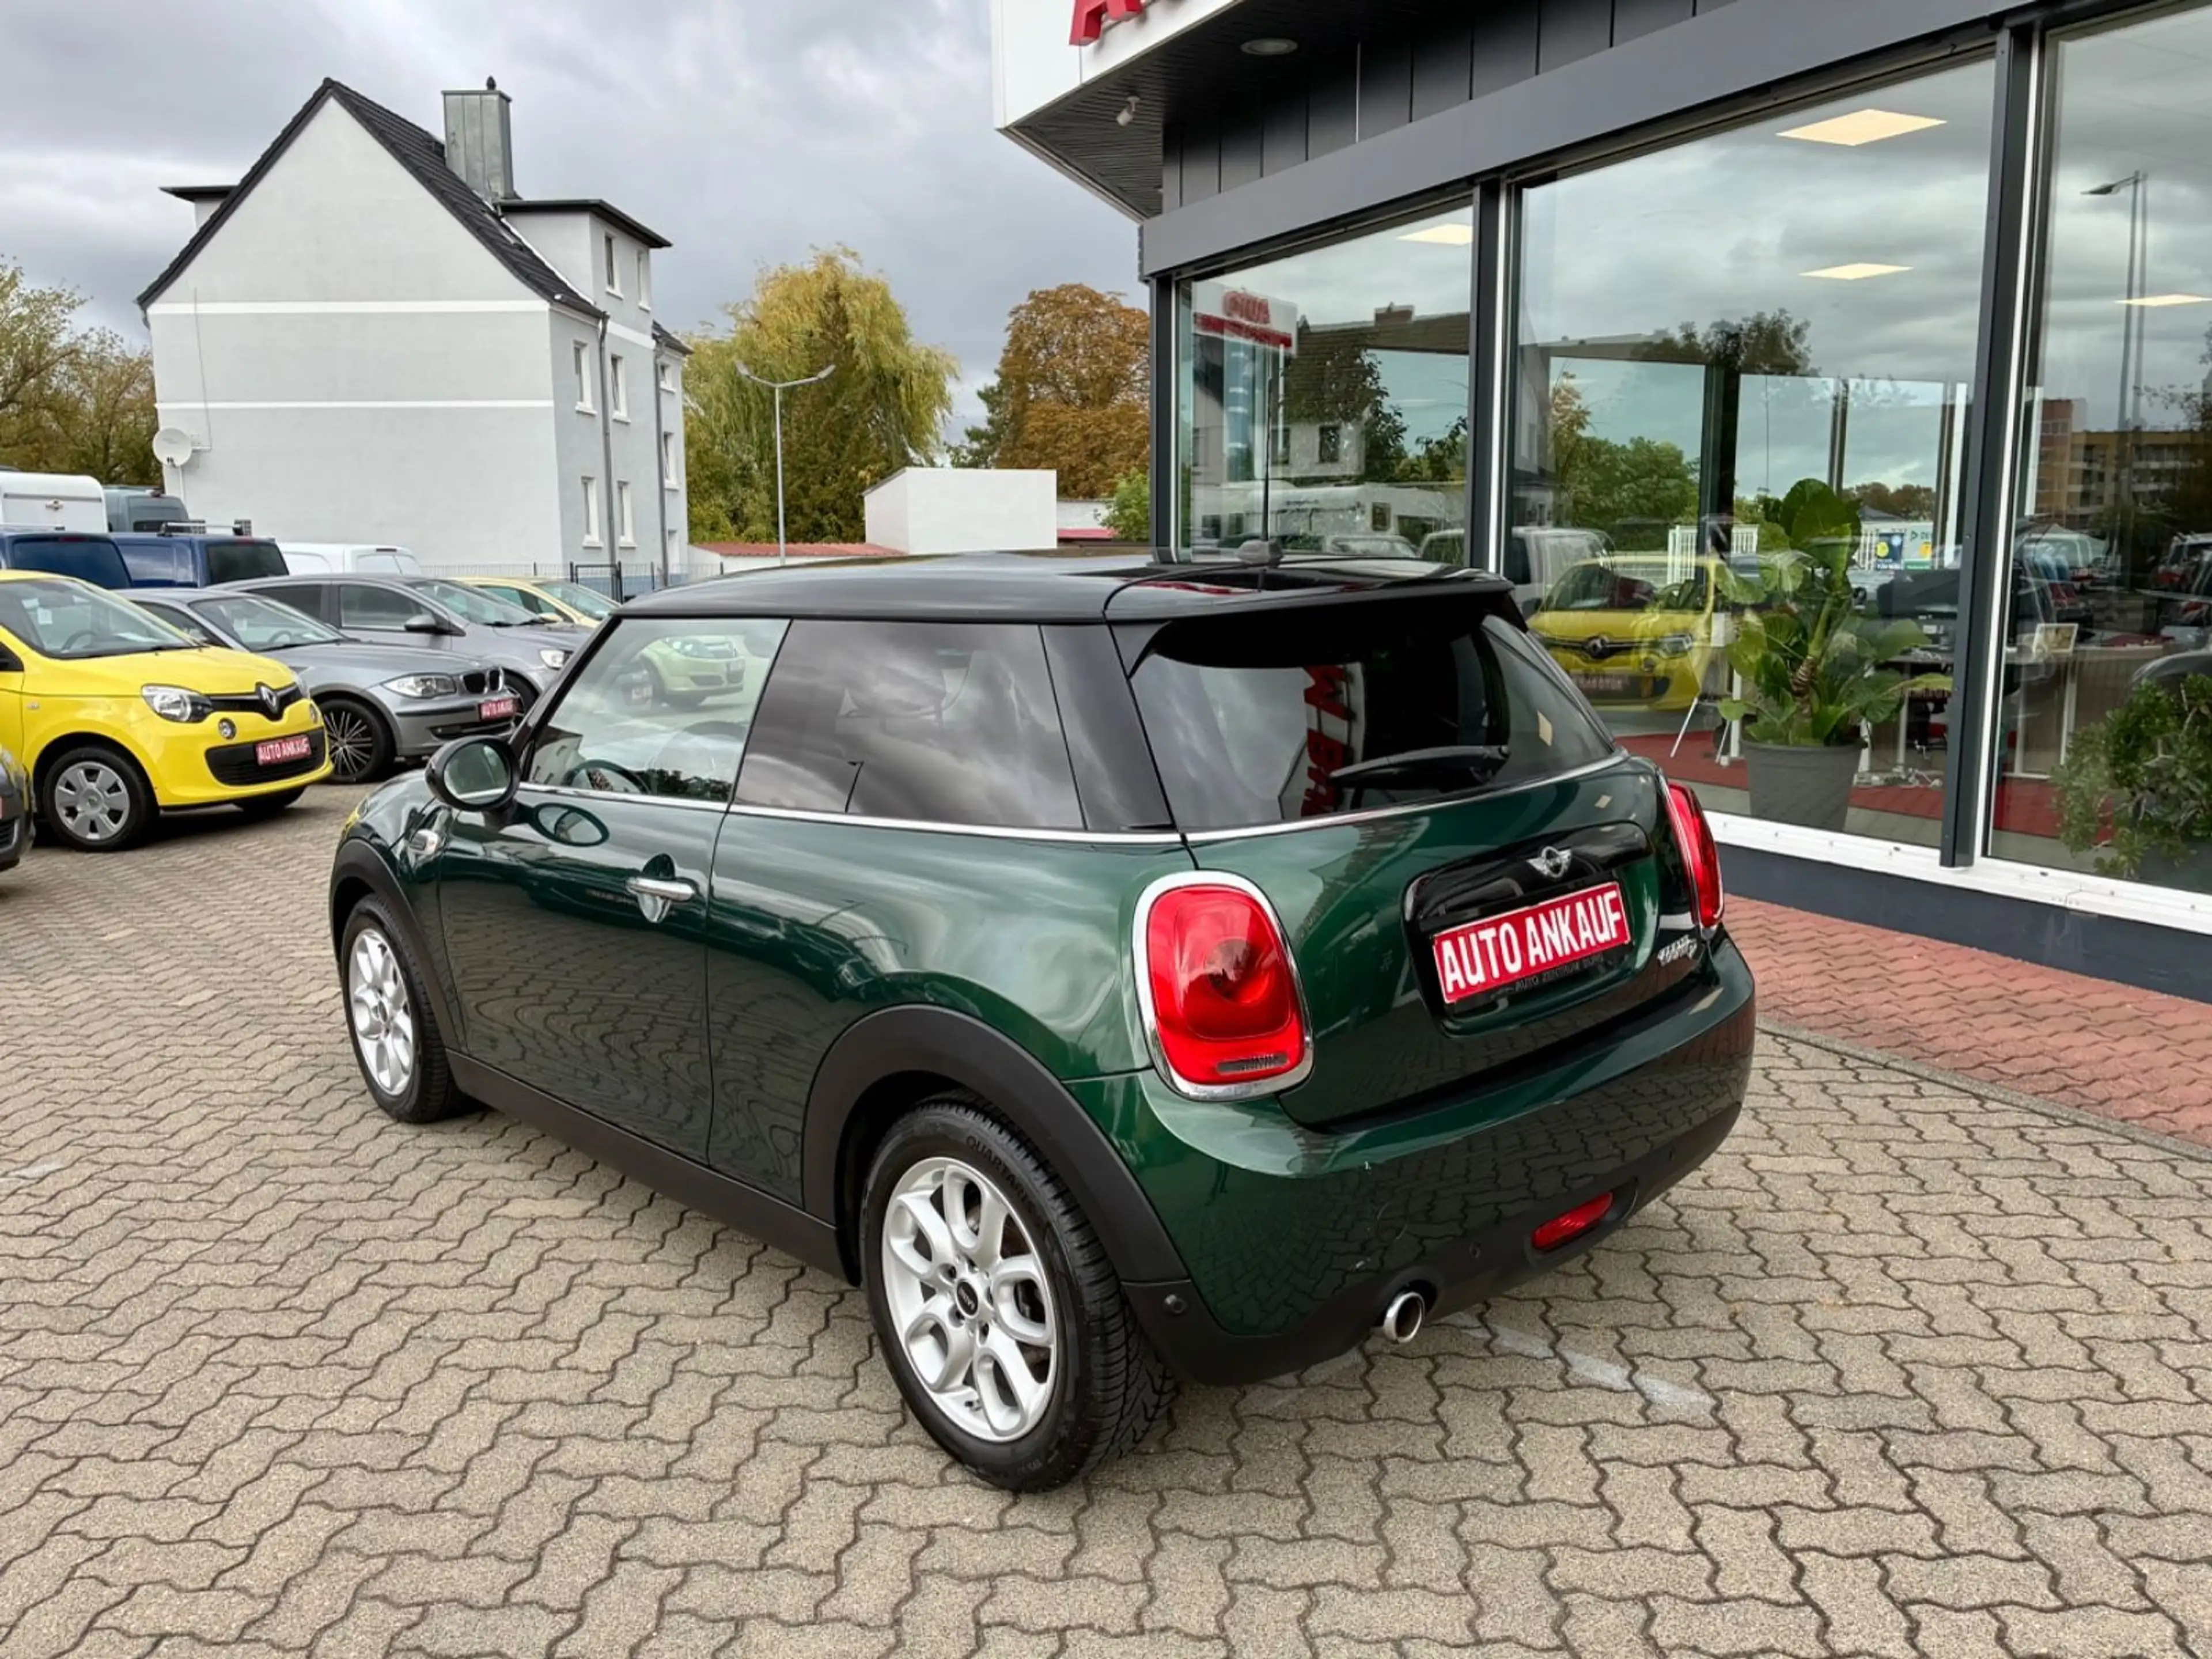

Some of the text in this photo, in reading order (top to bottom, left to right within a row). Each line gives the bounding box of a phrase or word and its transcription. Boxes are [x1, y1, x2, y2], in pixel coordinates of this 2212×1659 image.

[257, 737, 310, 762] AUTO ANKAUF
[1440, 922, 1522, 994] AUTO
[1525, 890, 1623, 967] ANKAUF
